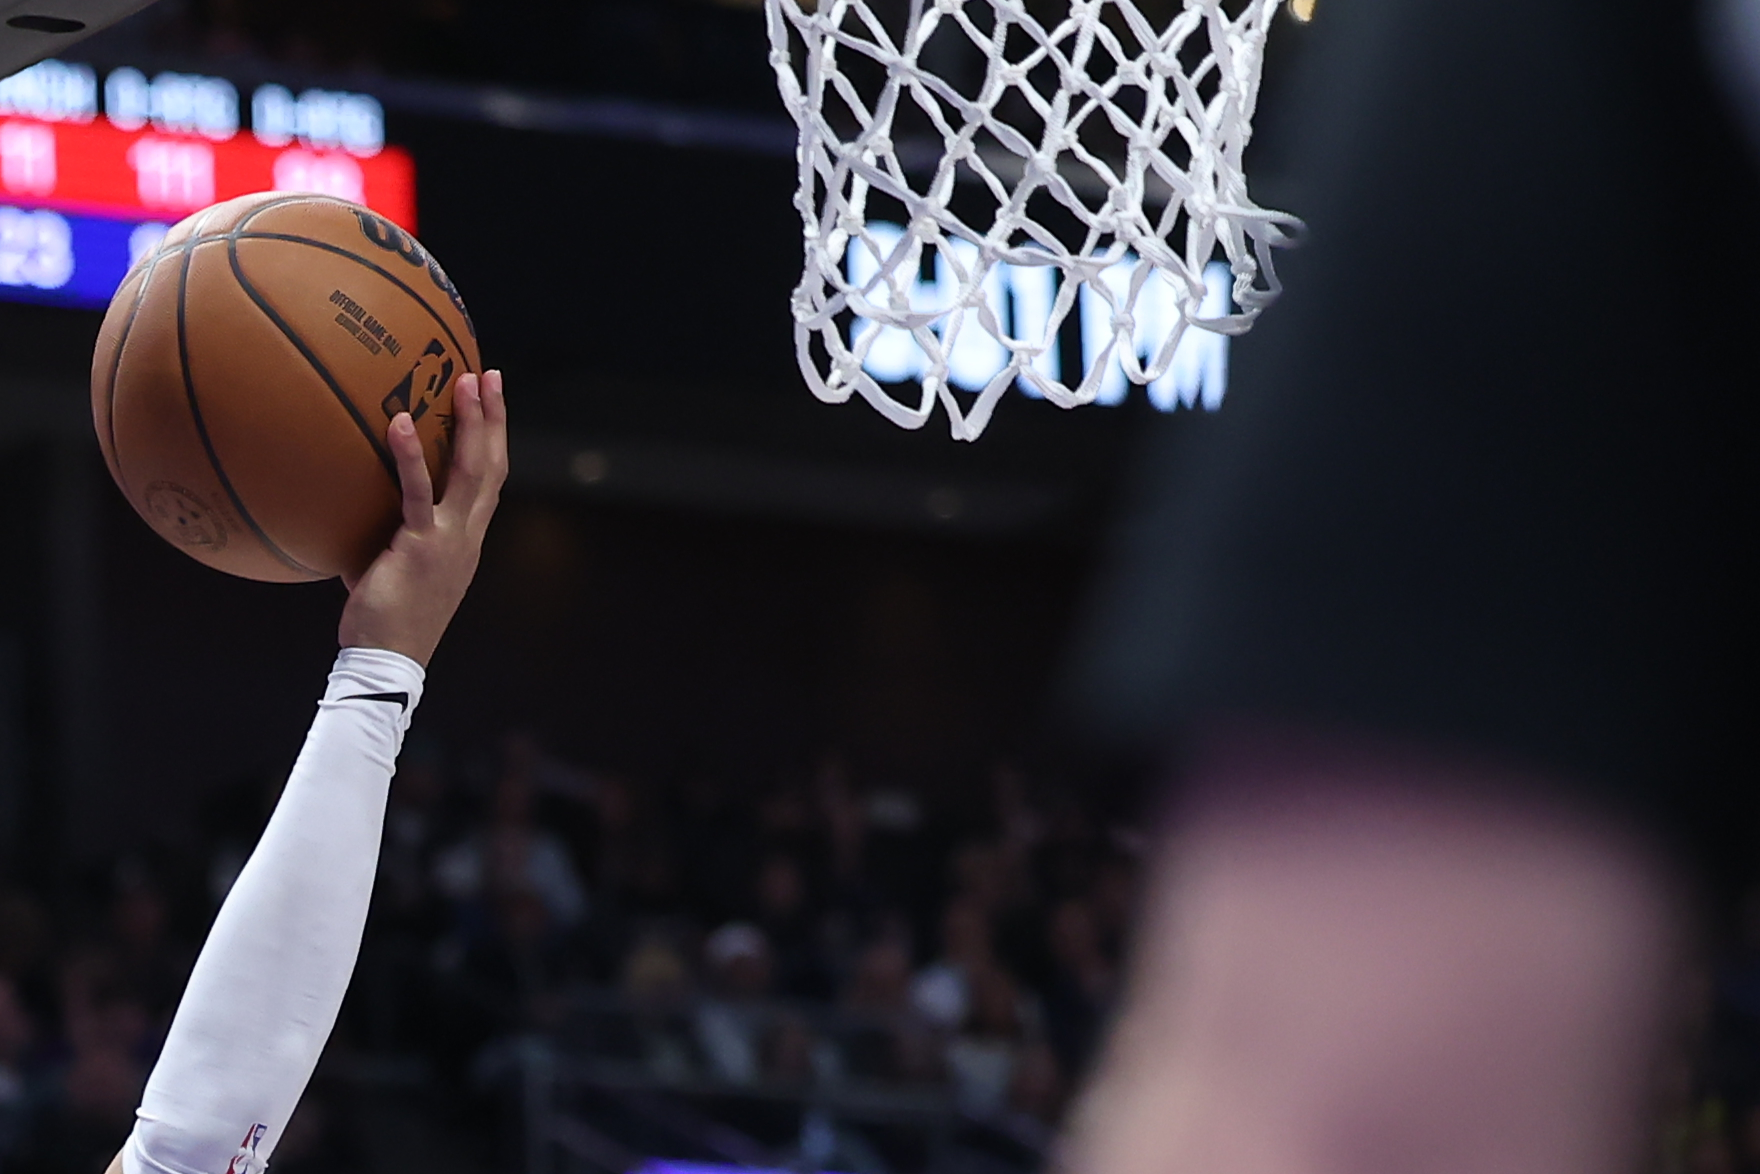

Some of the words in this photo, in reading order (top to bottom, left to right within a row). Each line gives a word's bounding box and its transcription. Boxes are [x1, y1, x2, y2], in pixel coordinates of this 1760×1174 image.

[329, 289, 367, 323] OFFICIAL
[363, 315, 388, 342] GAME
[382, 334, 402, 357] BALL
